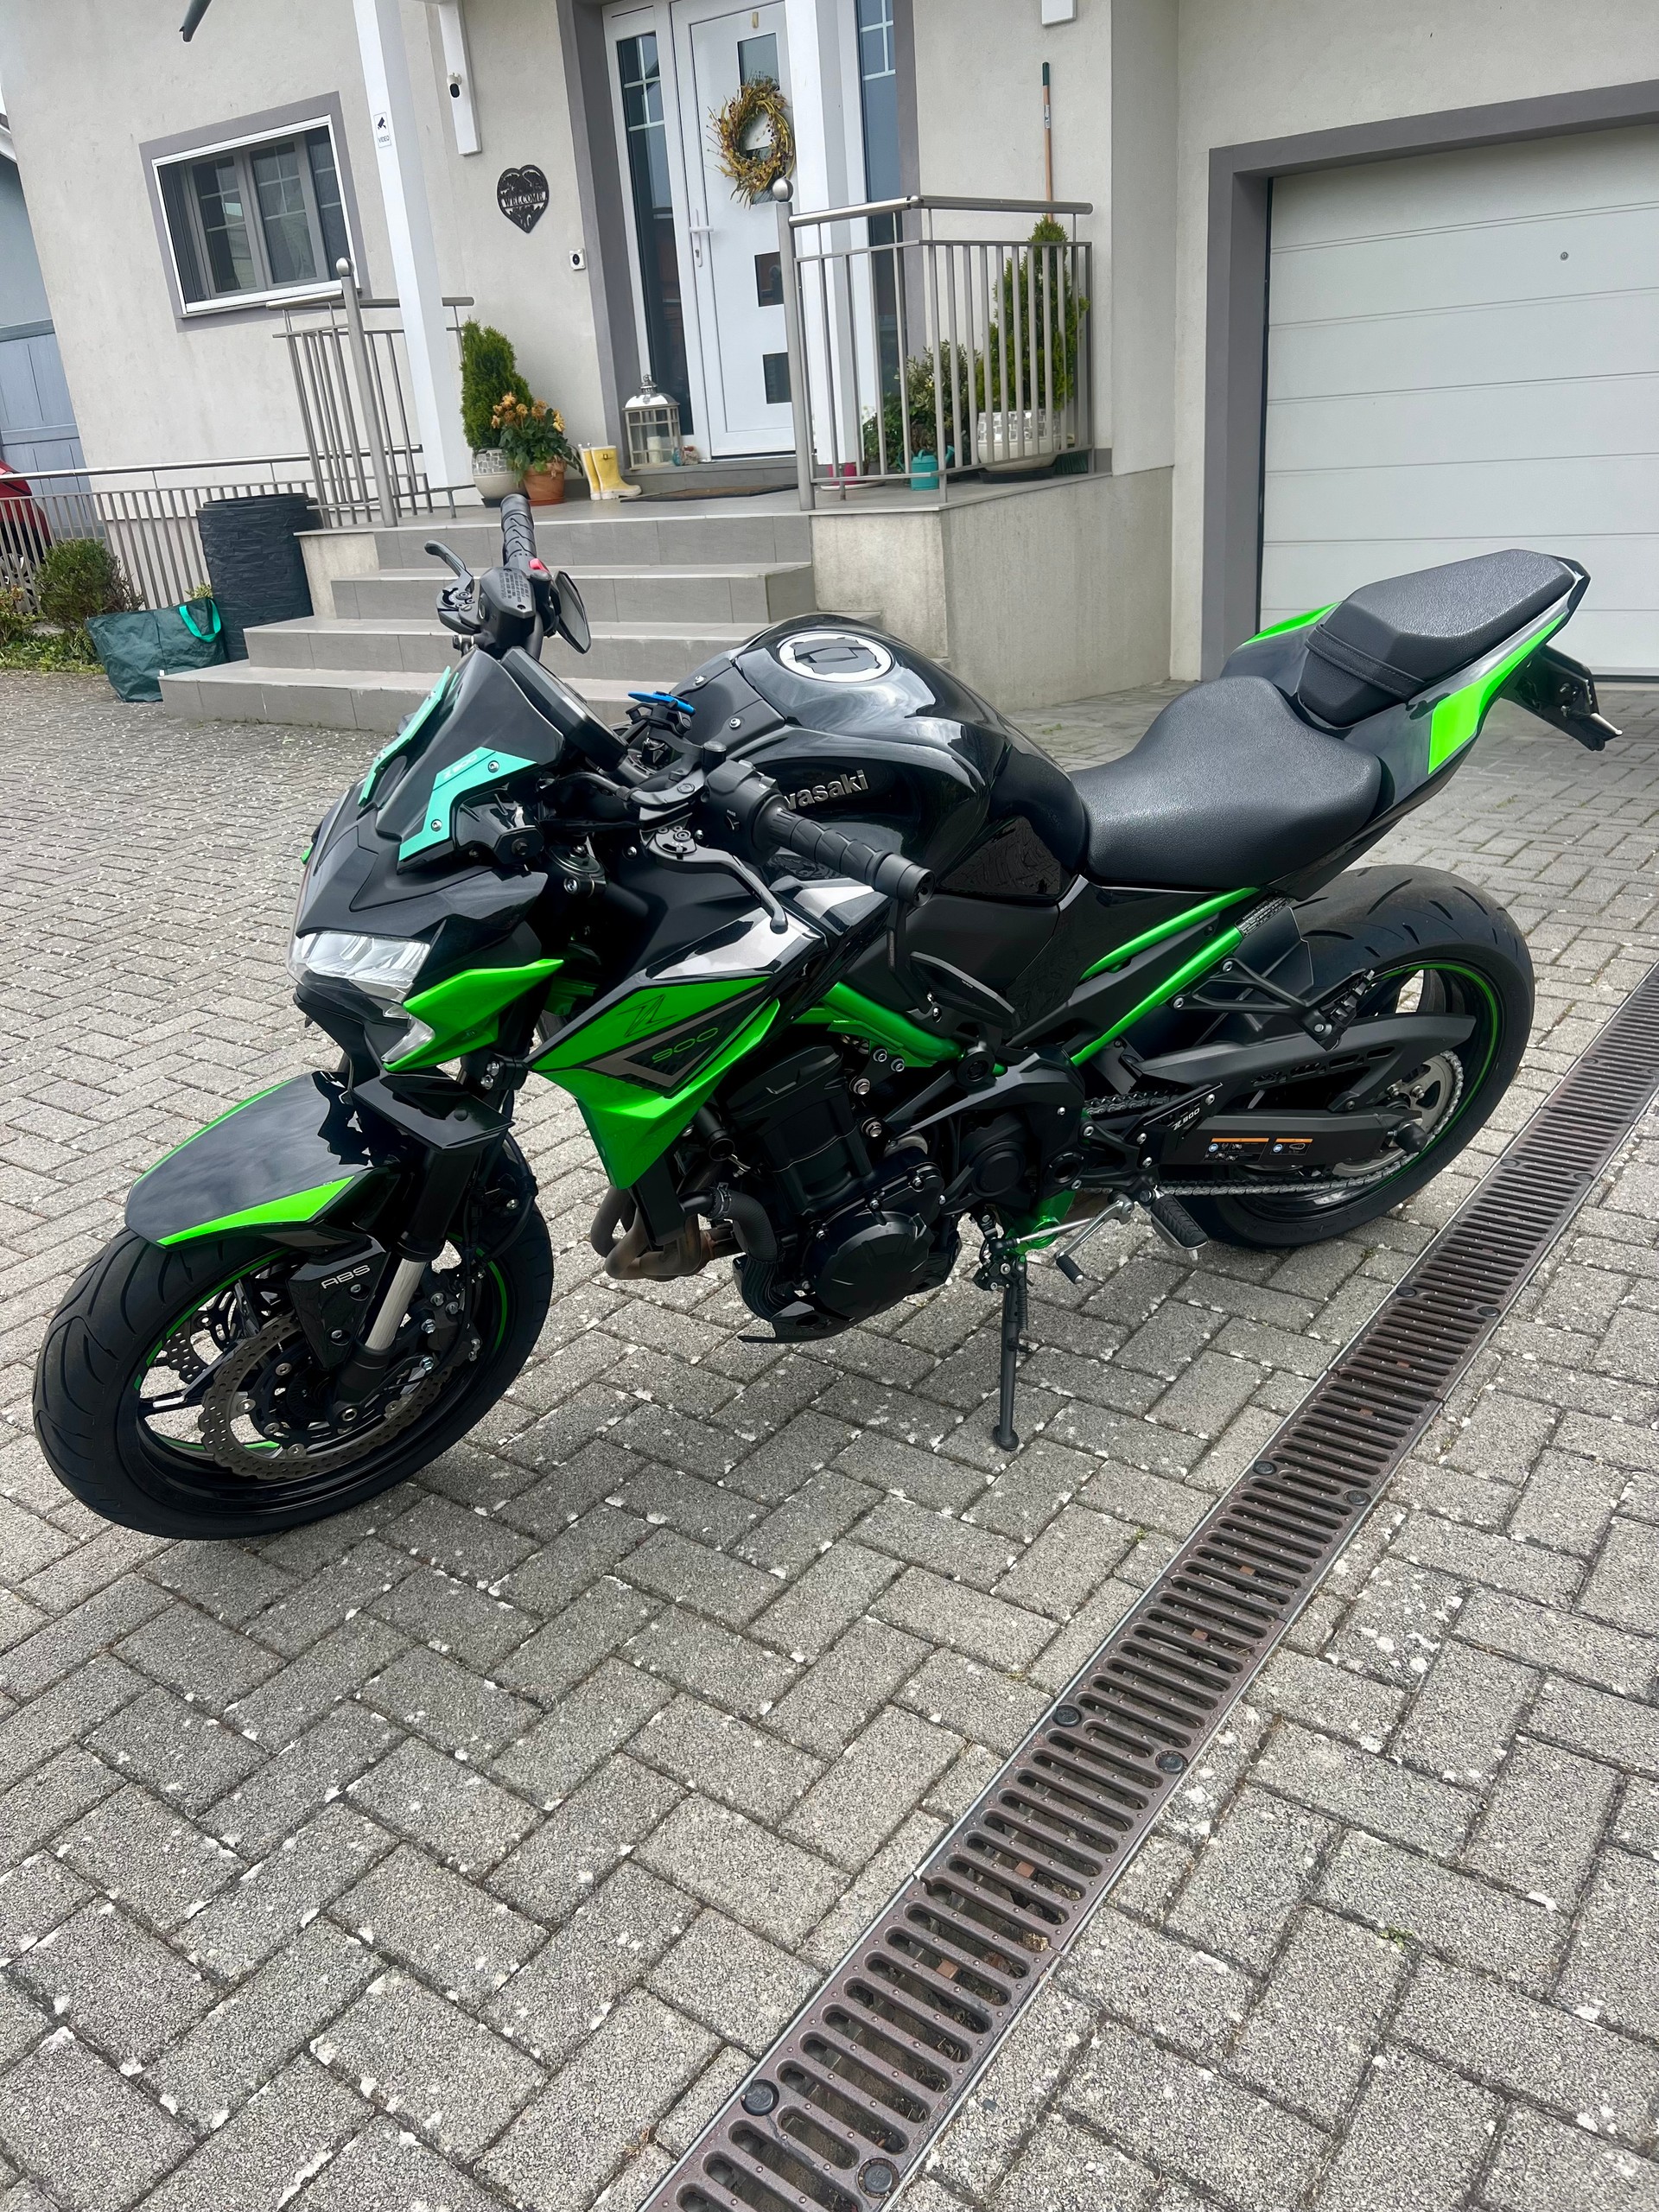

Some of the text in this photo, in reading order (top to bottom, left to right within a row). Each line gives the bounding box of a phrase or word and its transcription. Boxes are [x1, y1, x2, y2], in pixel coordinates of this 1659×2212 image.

[378, 135, 390, 143] VIDEO
[504, 192, 544, 207] WELCOME
[652, 1027, 719, 1064] 900
[321, 1264, 371, 1289] ABS
